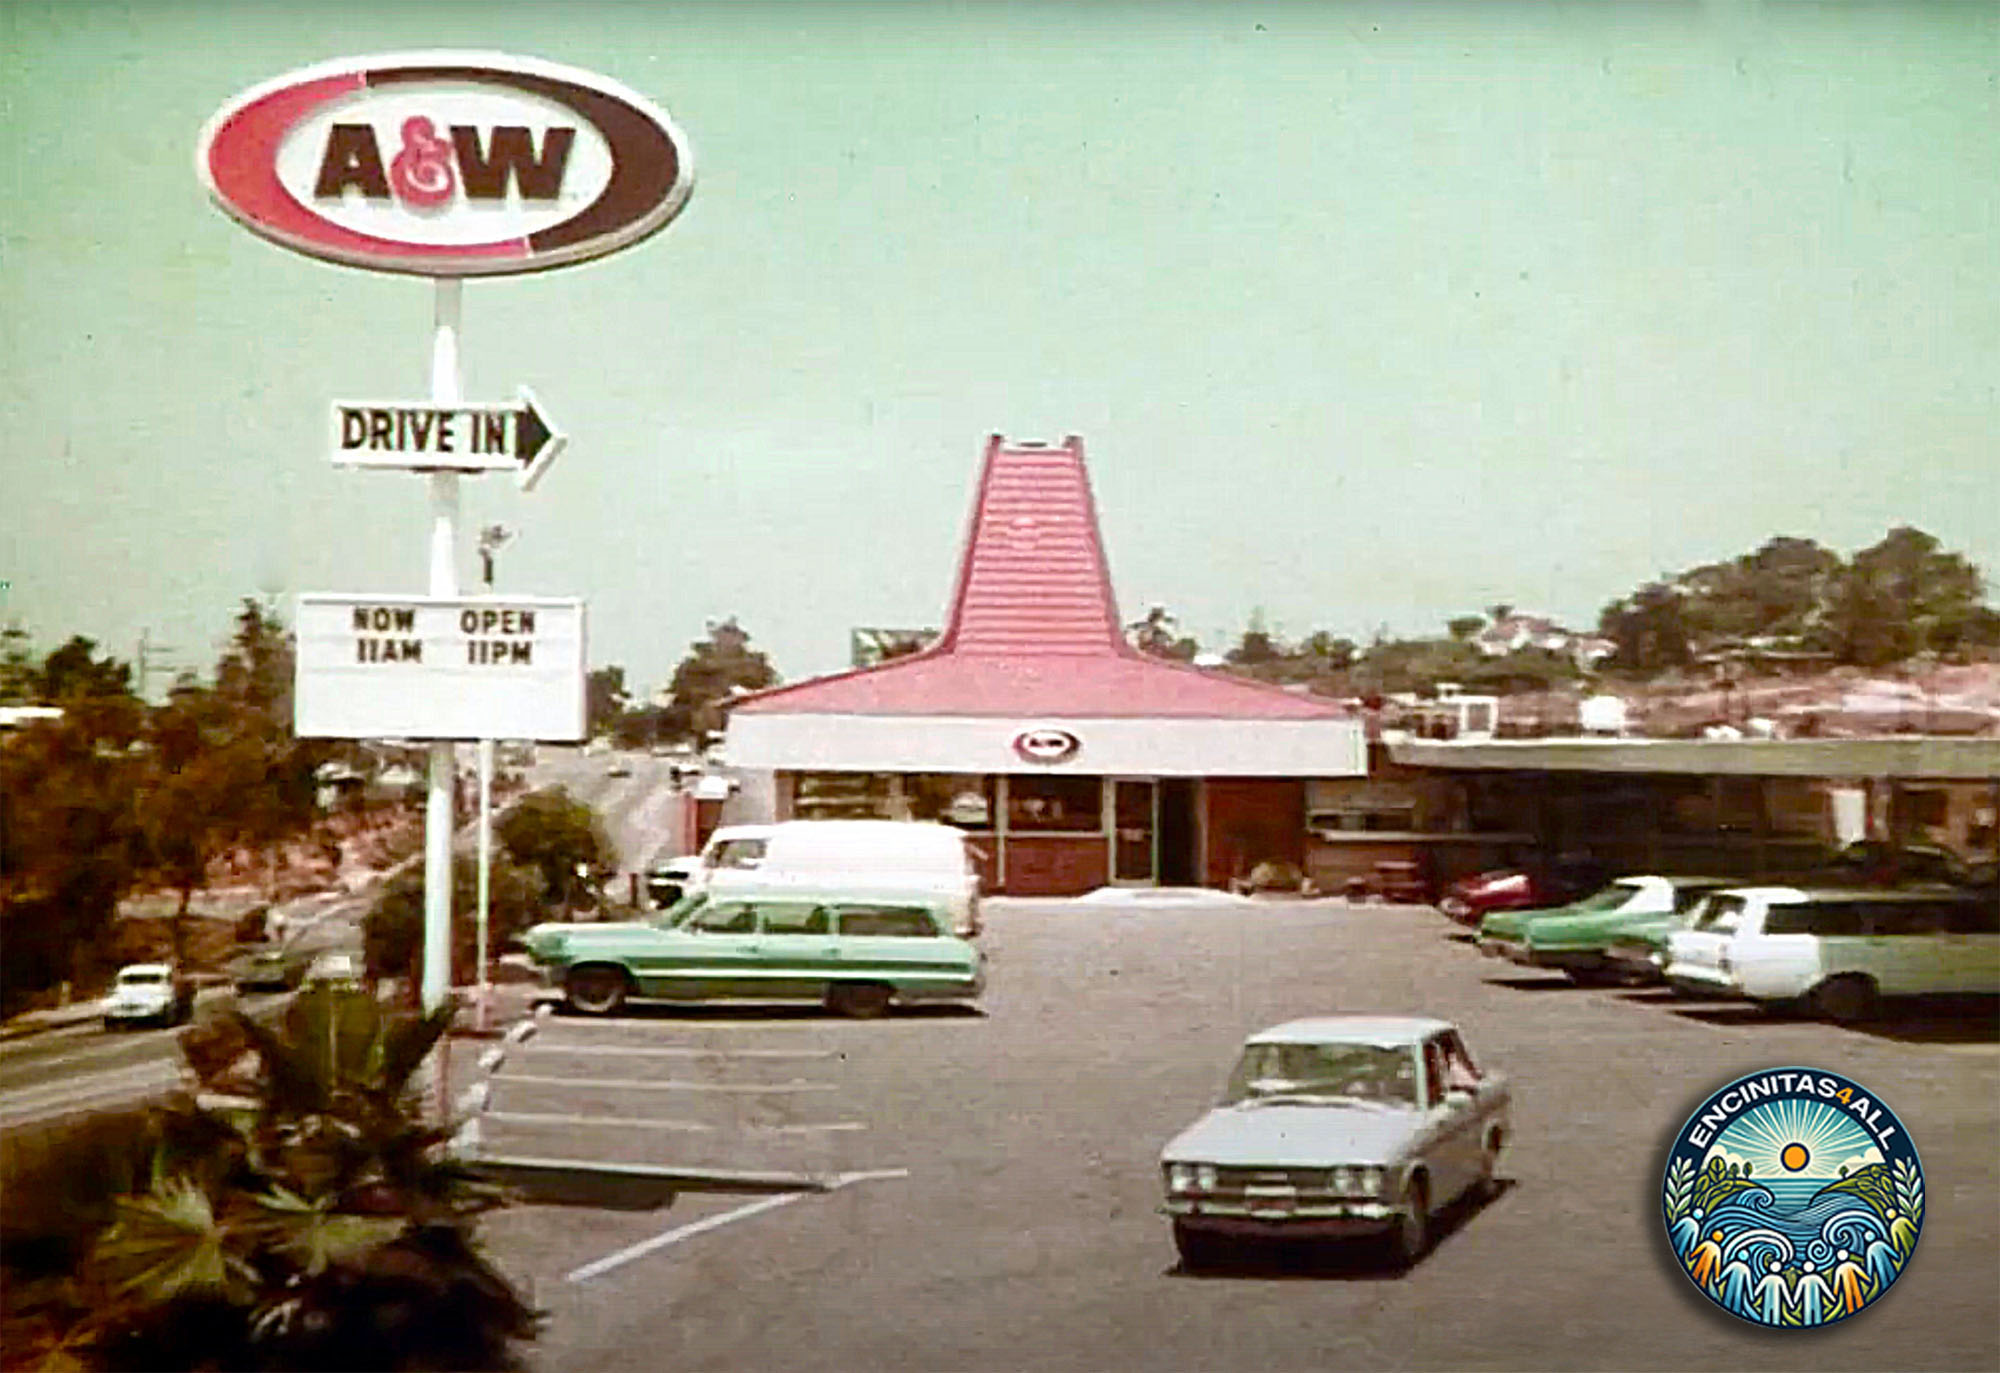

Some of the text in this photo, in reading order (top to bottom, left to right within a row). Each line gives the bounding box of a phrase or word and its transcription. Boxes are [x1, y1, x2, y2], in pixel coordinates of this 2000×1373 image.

[313, 115, 576, 208] A&W
[341, 409, 506, 454] DRIVE IN
[354, 607, 535, 634] NOW OPEN
